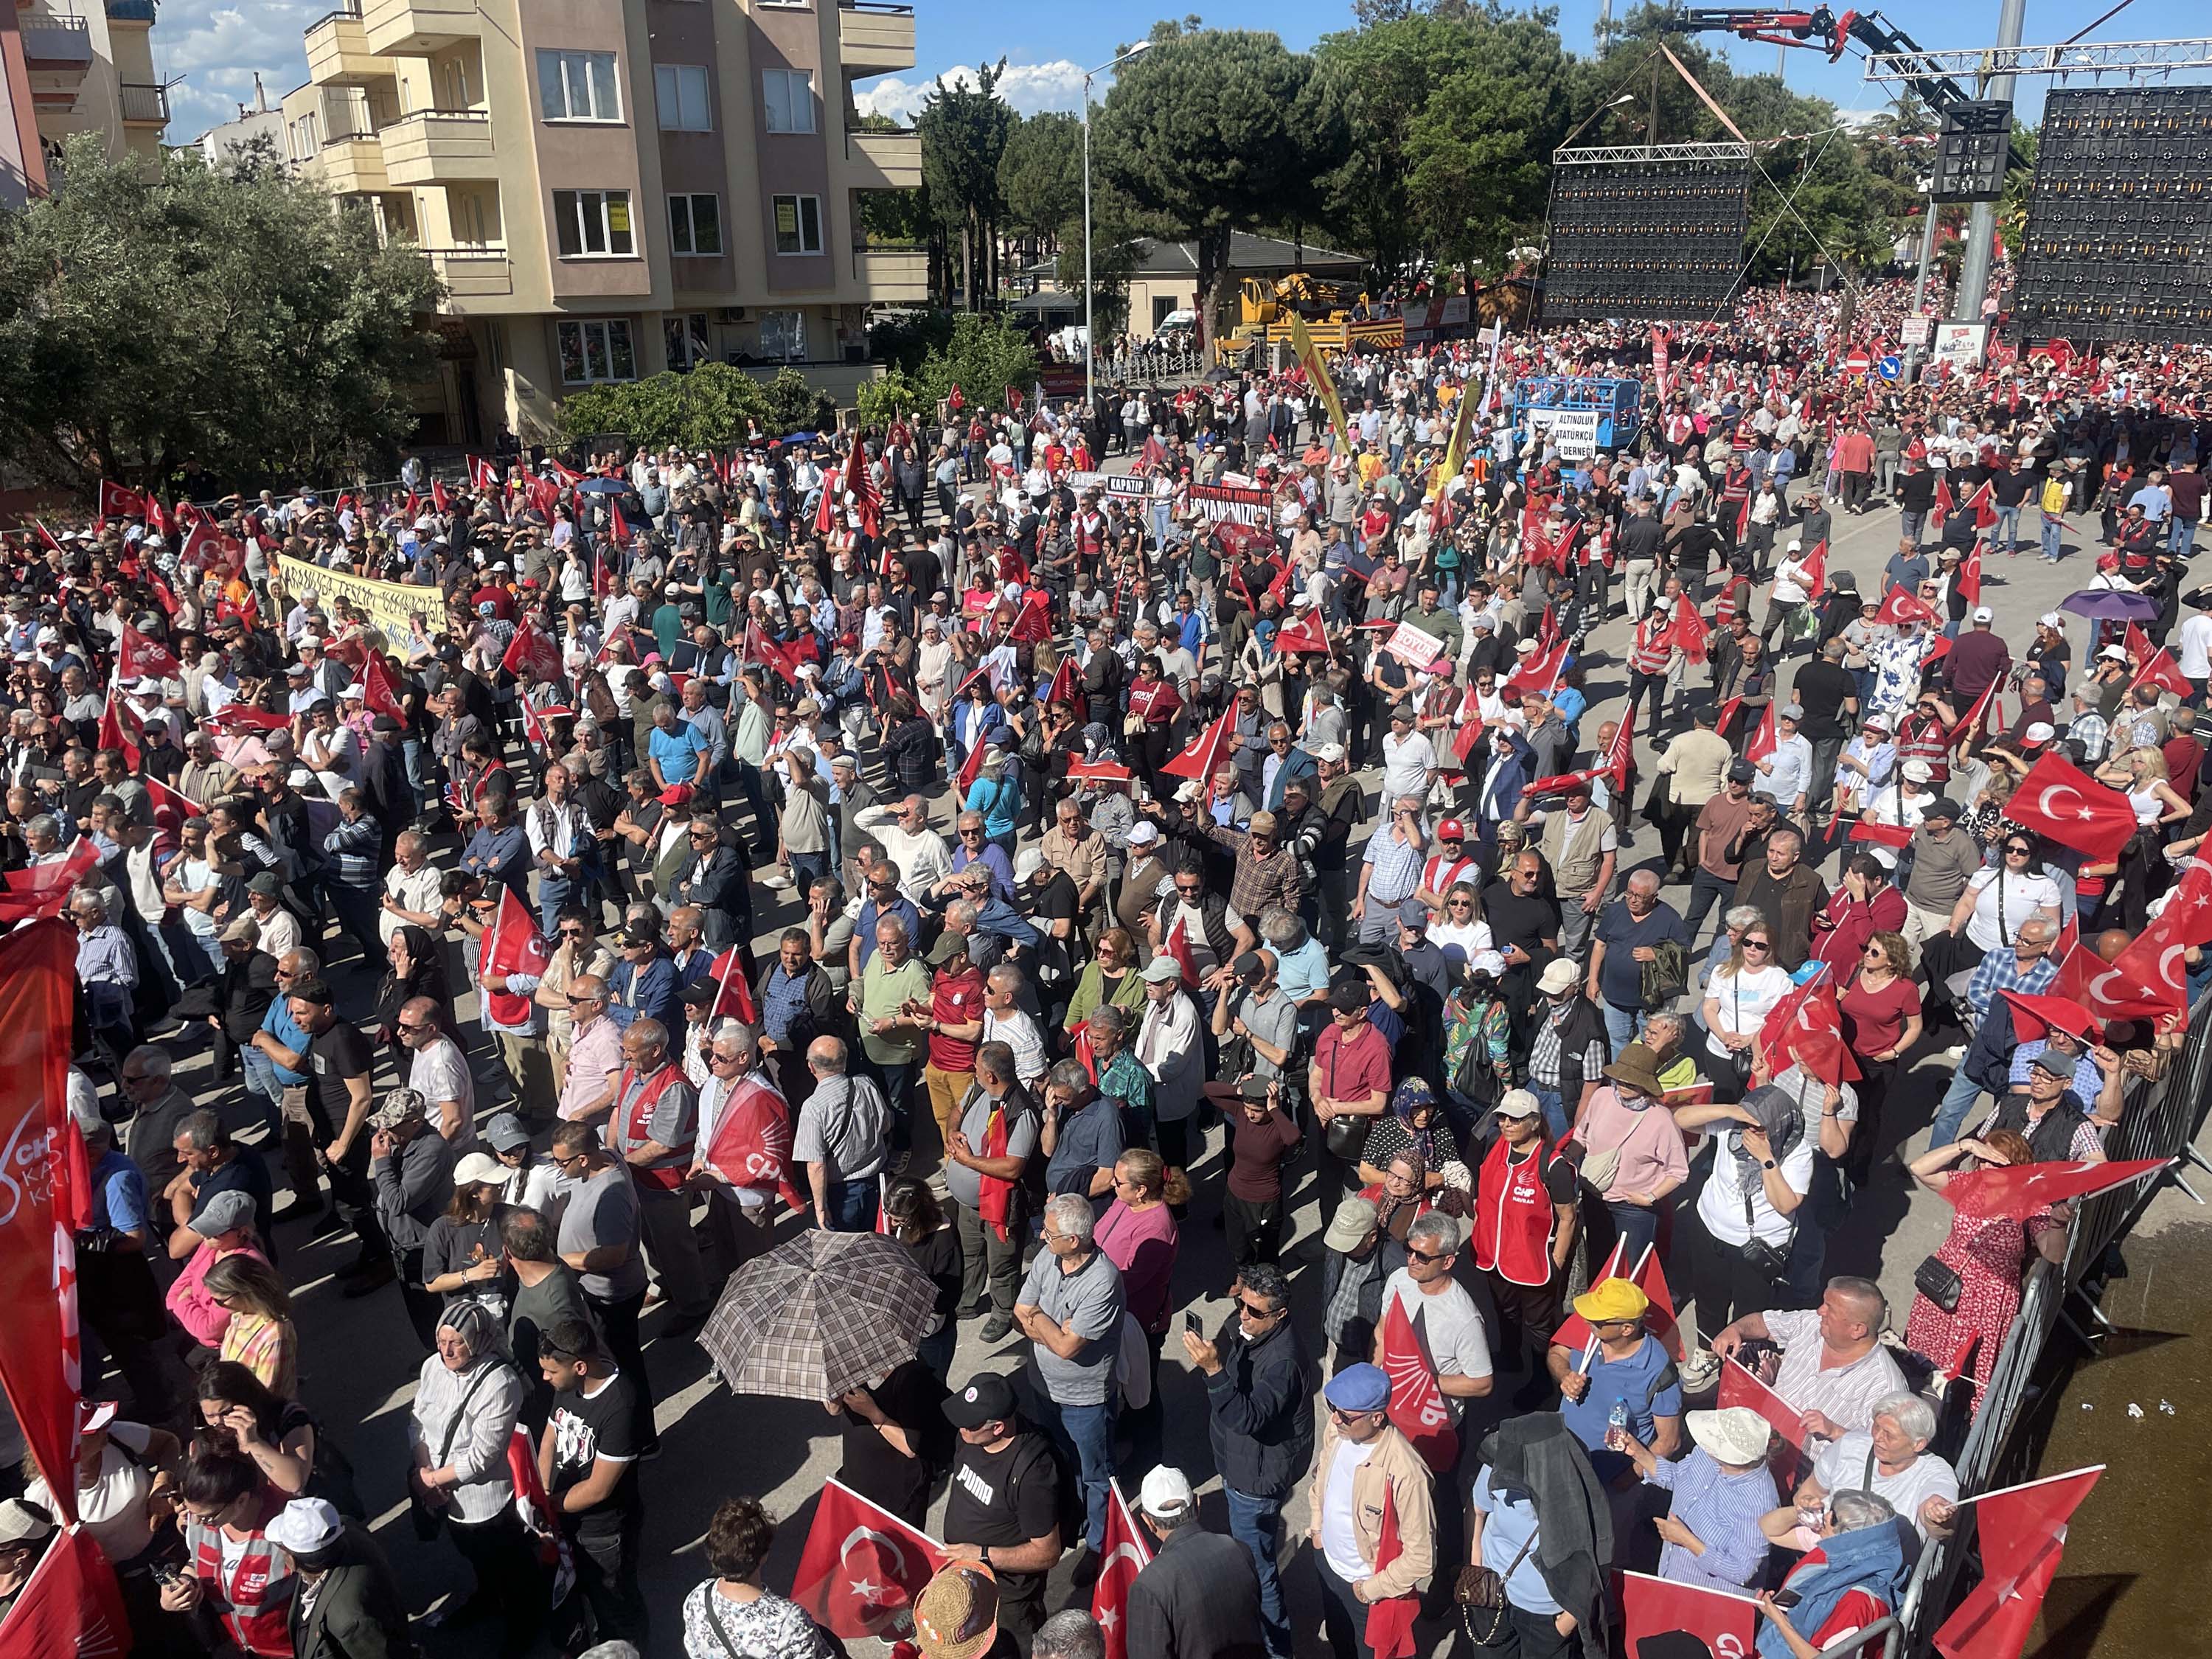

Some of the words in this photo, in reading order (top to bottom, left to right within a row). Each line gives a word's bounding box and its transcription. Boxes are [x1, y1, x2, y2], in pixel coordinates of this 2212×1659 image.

[1558, 414, 1594, 425] ALTINOLUK
[1555, 428, 1593, 442] ATATÜRKÇÜ
[1110, 478, 1144, 493] KAPATIP
[1394, 631, 1435, 658] BOYUN
[528, 938, 554, 959] CH
[15, 1127, 58, 1165] CHP
[1513, 1186, 1535, 1197] CHP
[956, 1463, 994, 1506] PUMA
